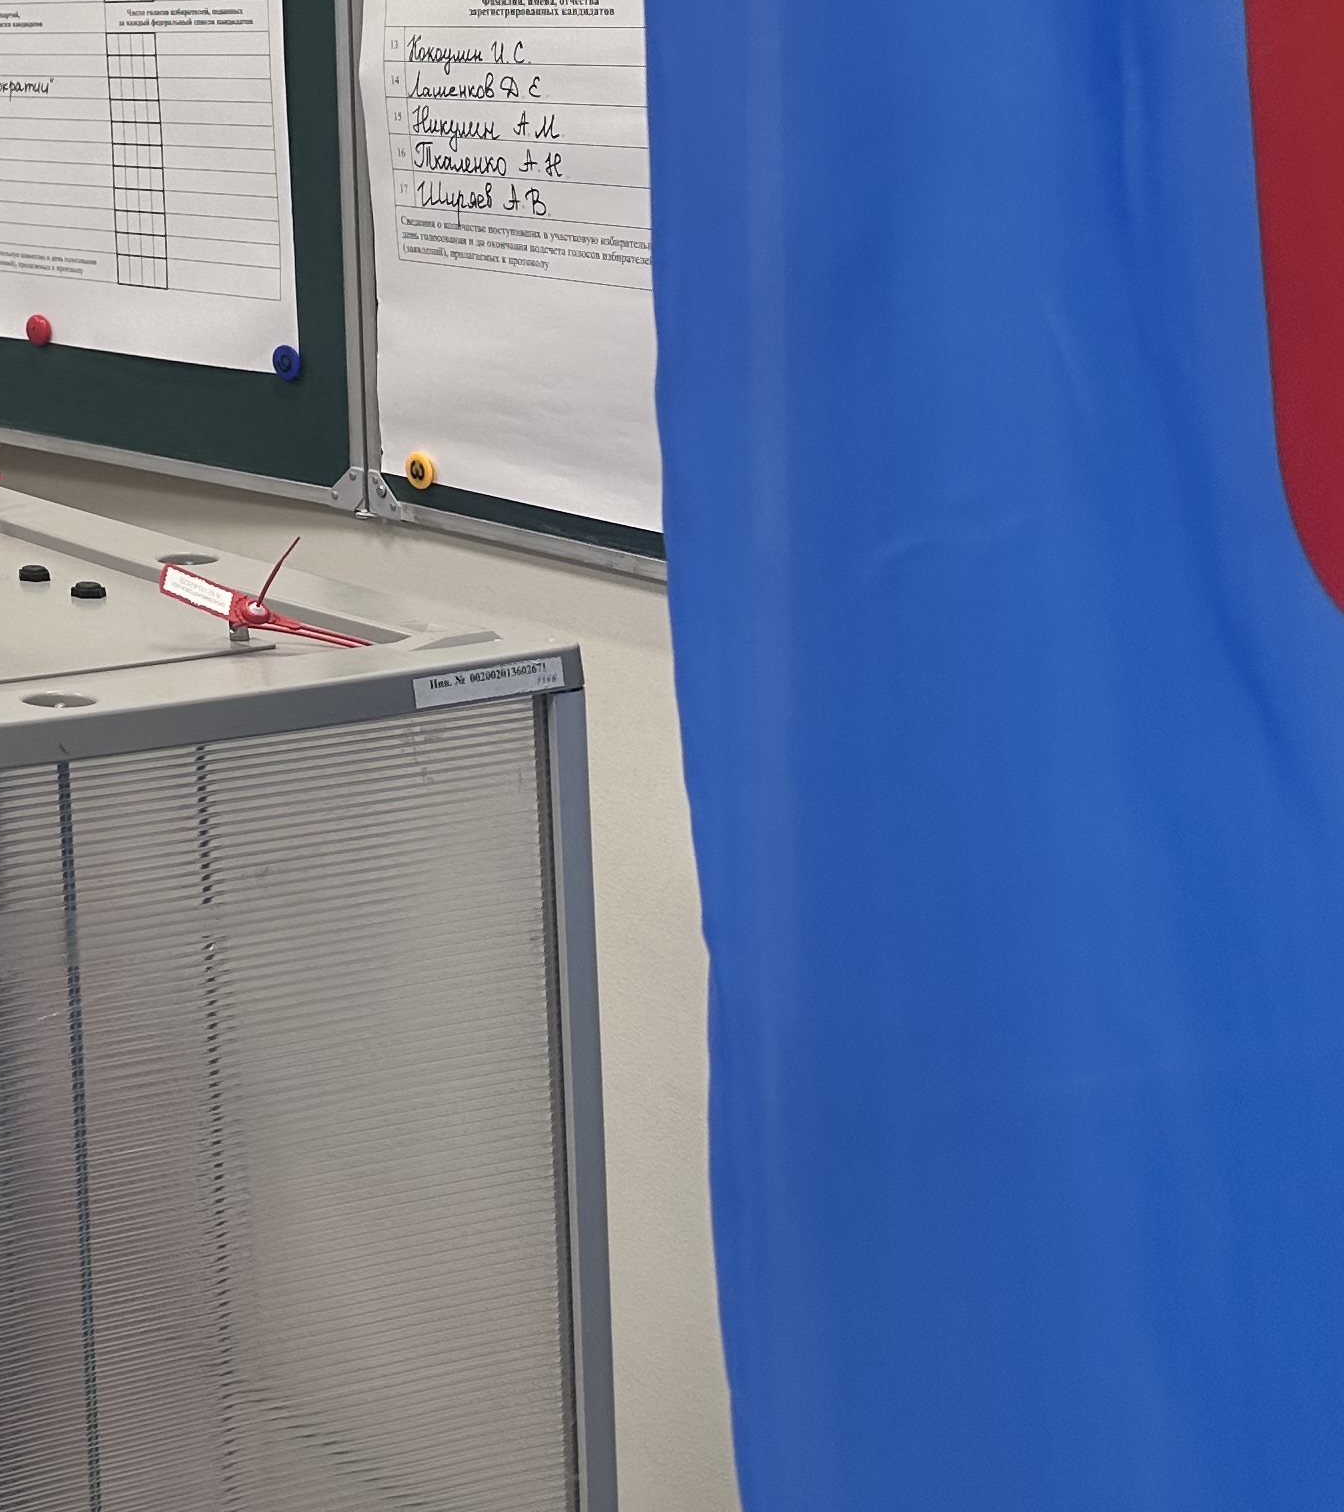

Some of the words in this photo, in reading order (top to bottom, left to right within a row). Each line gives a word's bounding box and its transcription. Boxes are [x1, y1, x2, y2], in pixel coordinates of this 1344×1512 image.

[561, 7, 615, 16] кандидатов
[406, 34, 483, 75] Кокоулин
[408, 70, 494, 99] Лашенков
[412, 105, 500, 152] Никулин
[414, 141, 507, 176] Ткаленко
[417, 180, 494, 227] Ширяев
